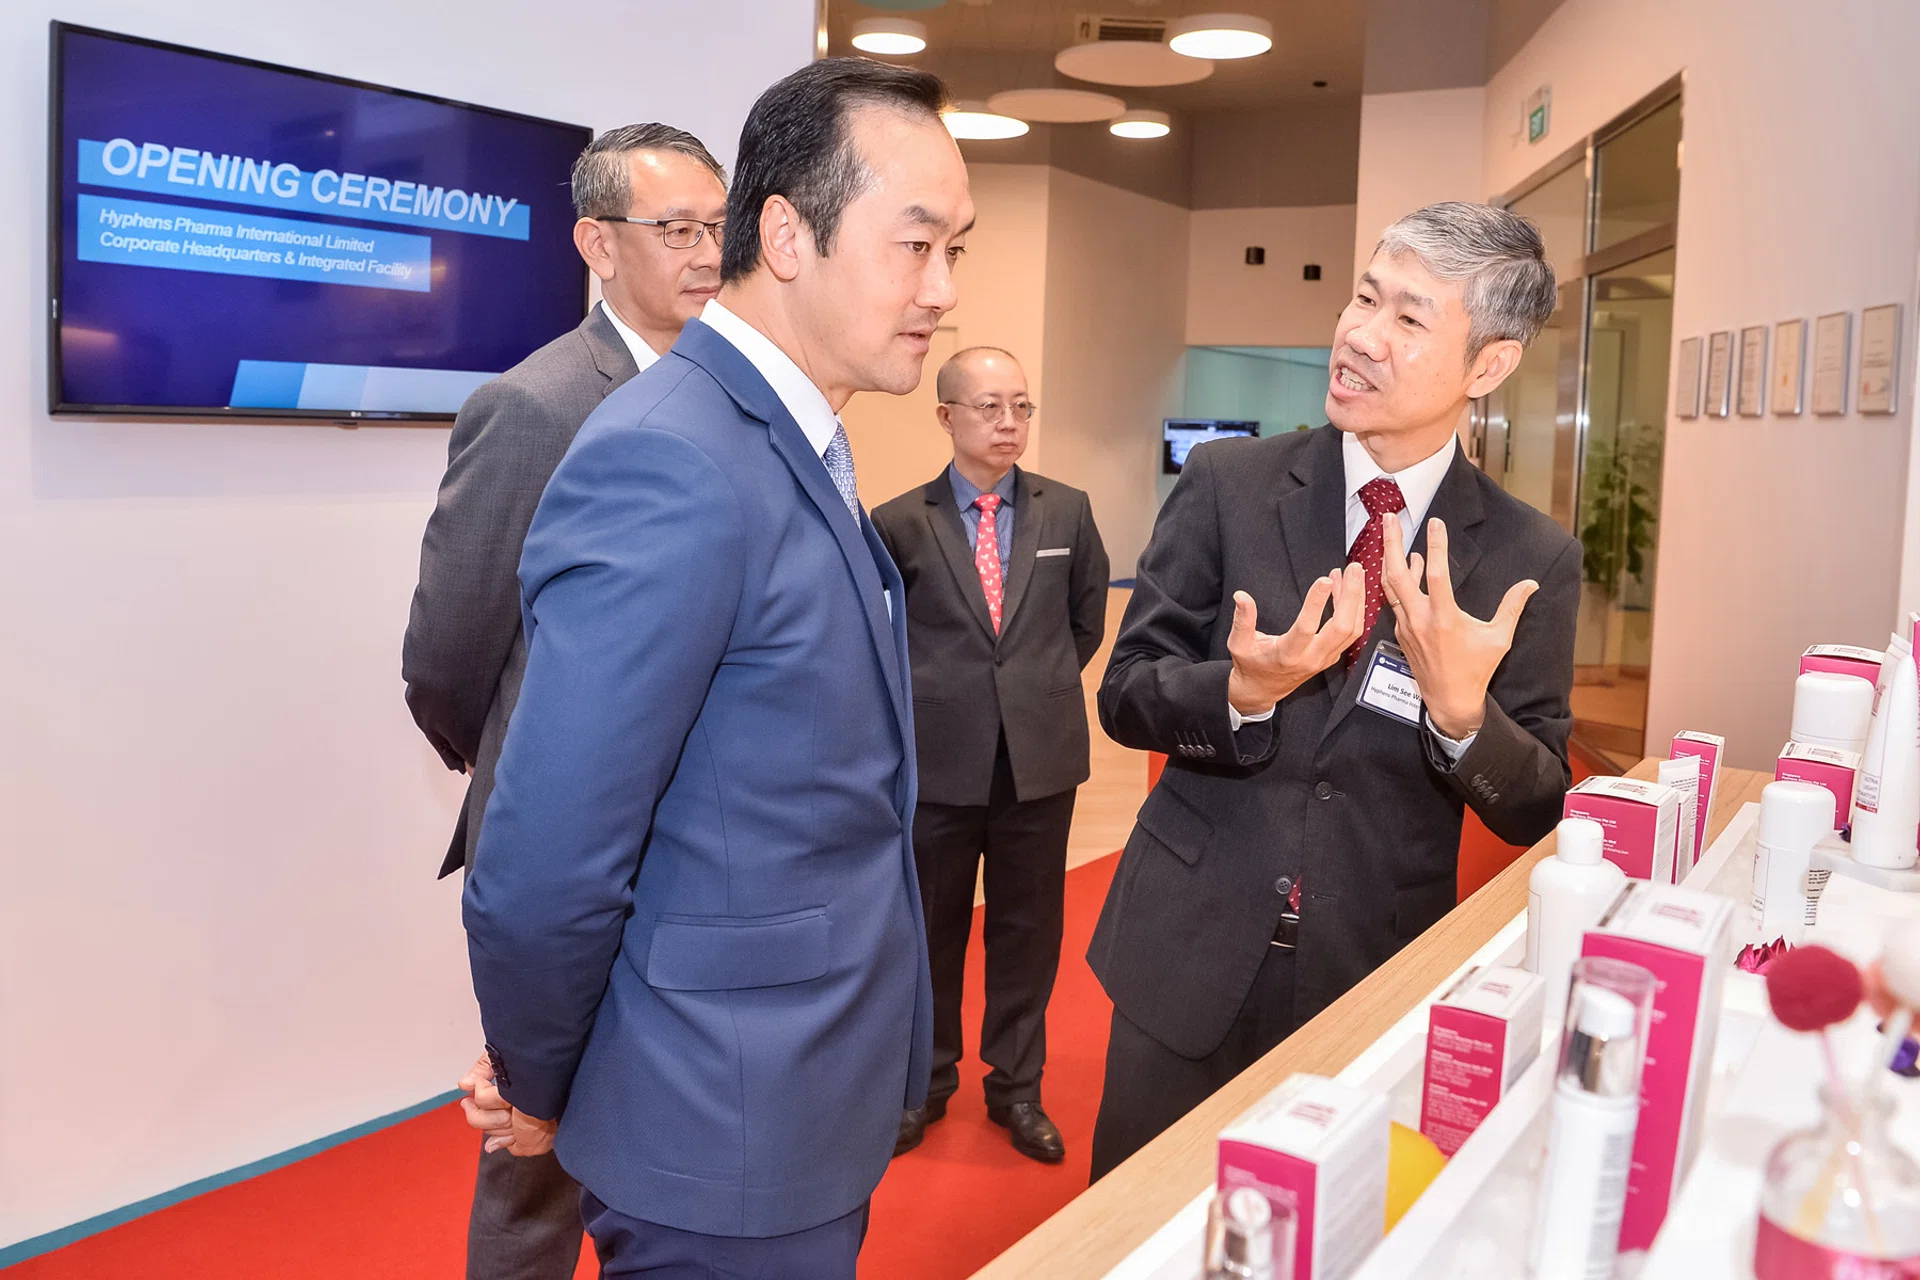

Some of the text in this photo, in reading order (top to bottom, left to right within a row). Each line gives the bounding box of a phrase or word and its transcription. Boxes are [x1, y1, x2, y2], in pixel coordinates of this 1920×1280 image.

[102, 137, 518, 227] OPENING CEREMONY
[99, 208, 375, 253] Hyphens Pharma International Limited
[100, 231, 412, 280] Corporate Headquarters & Integrated Facility
[1370, 686, 1391, 698] Hyphens
[1391, 694, 1409, 705] Pharma
[1387, 683, 1400, 693] Lim
[1400, 688, 1412, 697] See
